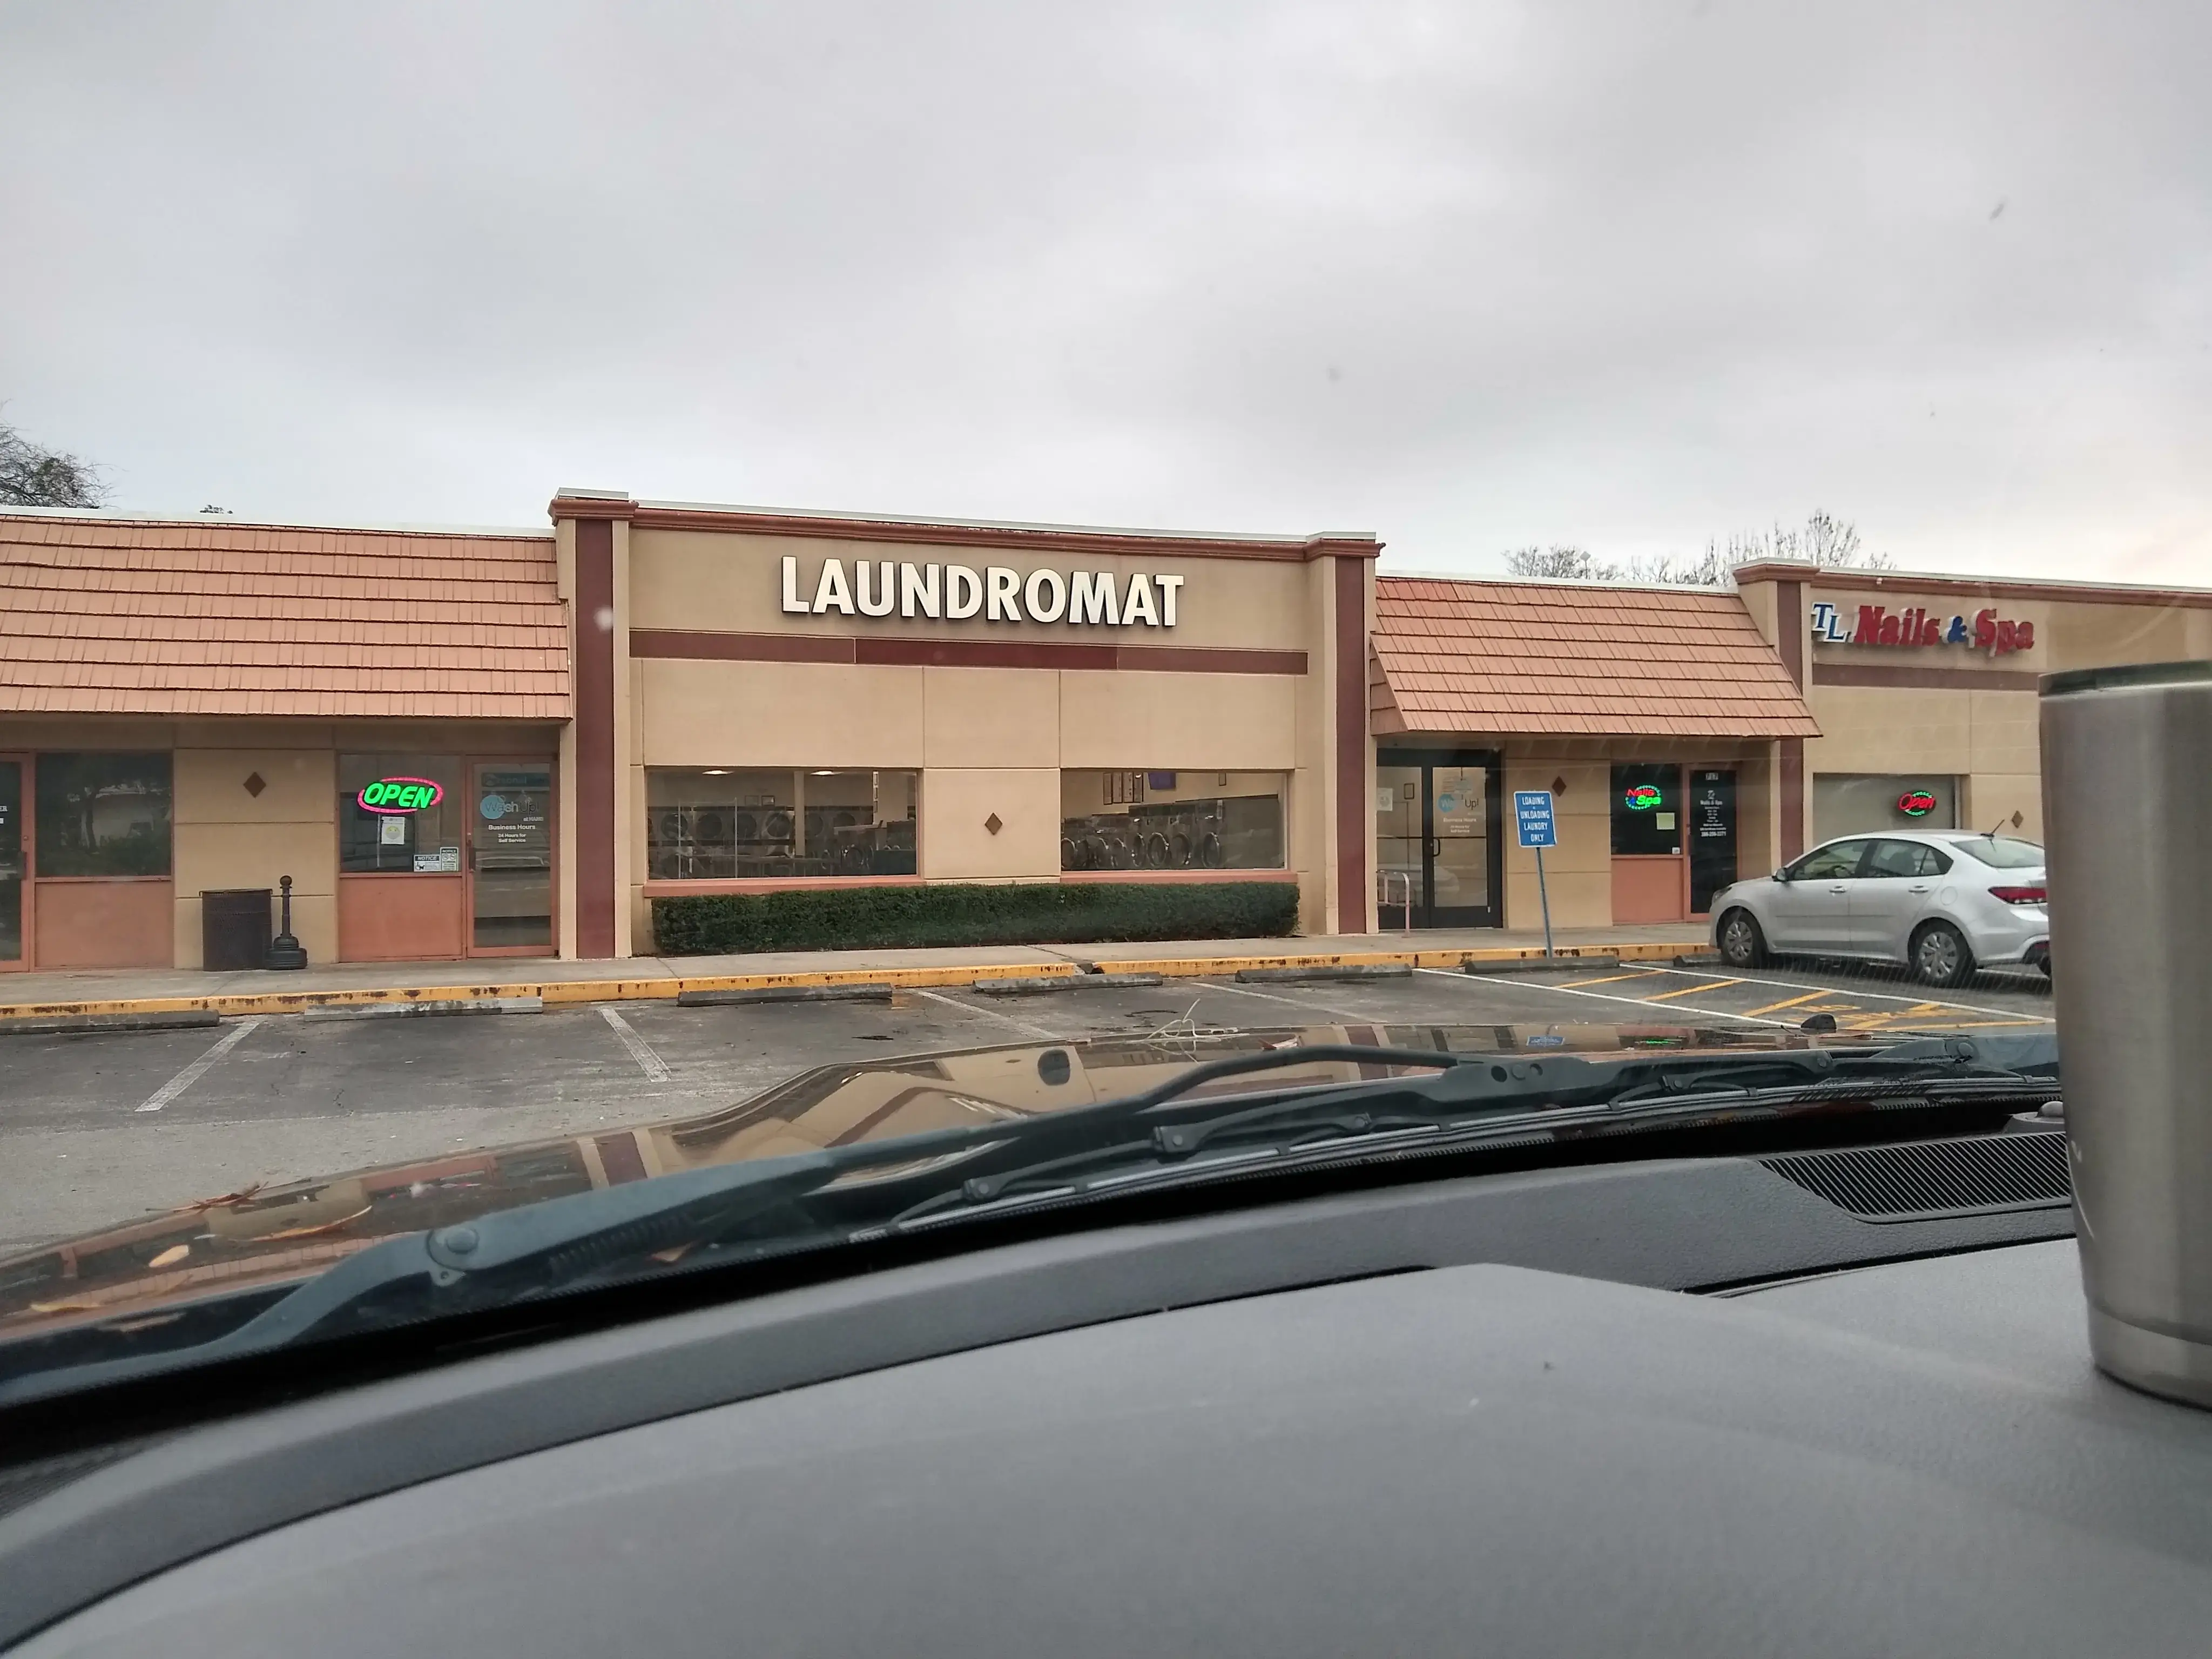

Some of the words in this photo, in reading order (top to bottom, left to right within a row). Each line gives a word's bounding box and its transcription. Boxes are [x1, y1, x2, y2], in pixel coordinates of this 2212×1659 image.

[781, 556, 1184, 626] LAUNDROMAT
[1812, 602, 1847, 643] TL
[1853, 605, 1941, 646] Nails
[1947, 616, 1967, 643] &
[1973, 608, 2035, 657] Spa
[363, 783, 435, 808] OPEN
[1522, 797, 1545, 805] LOADING
[1636, 795, 1661, 808] Spa
[1899, 793, 1936, 810] Open
[1465, 798, 1479, 811] Up!
[1520, 810, 1550, 819] UNLOADING
[1523, 822, 1548, 831] LAUNDRY
[1530, 834, 1544, 842] ONLY
